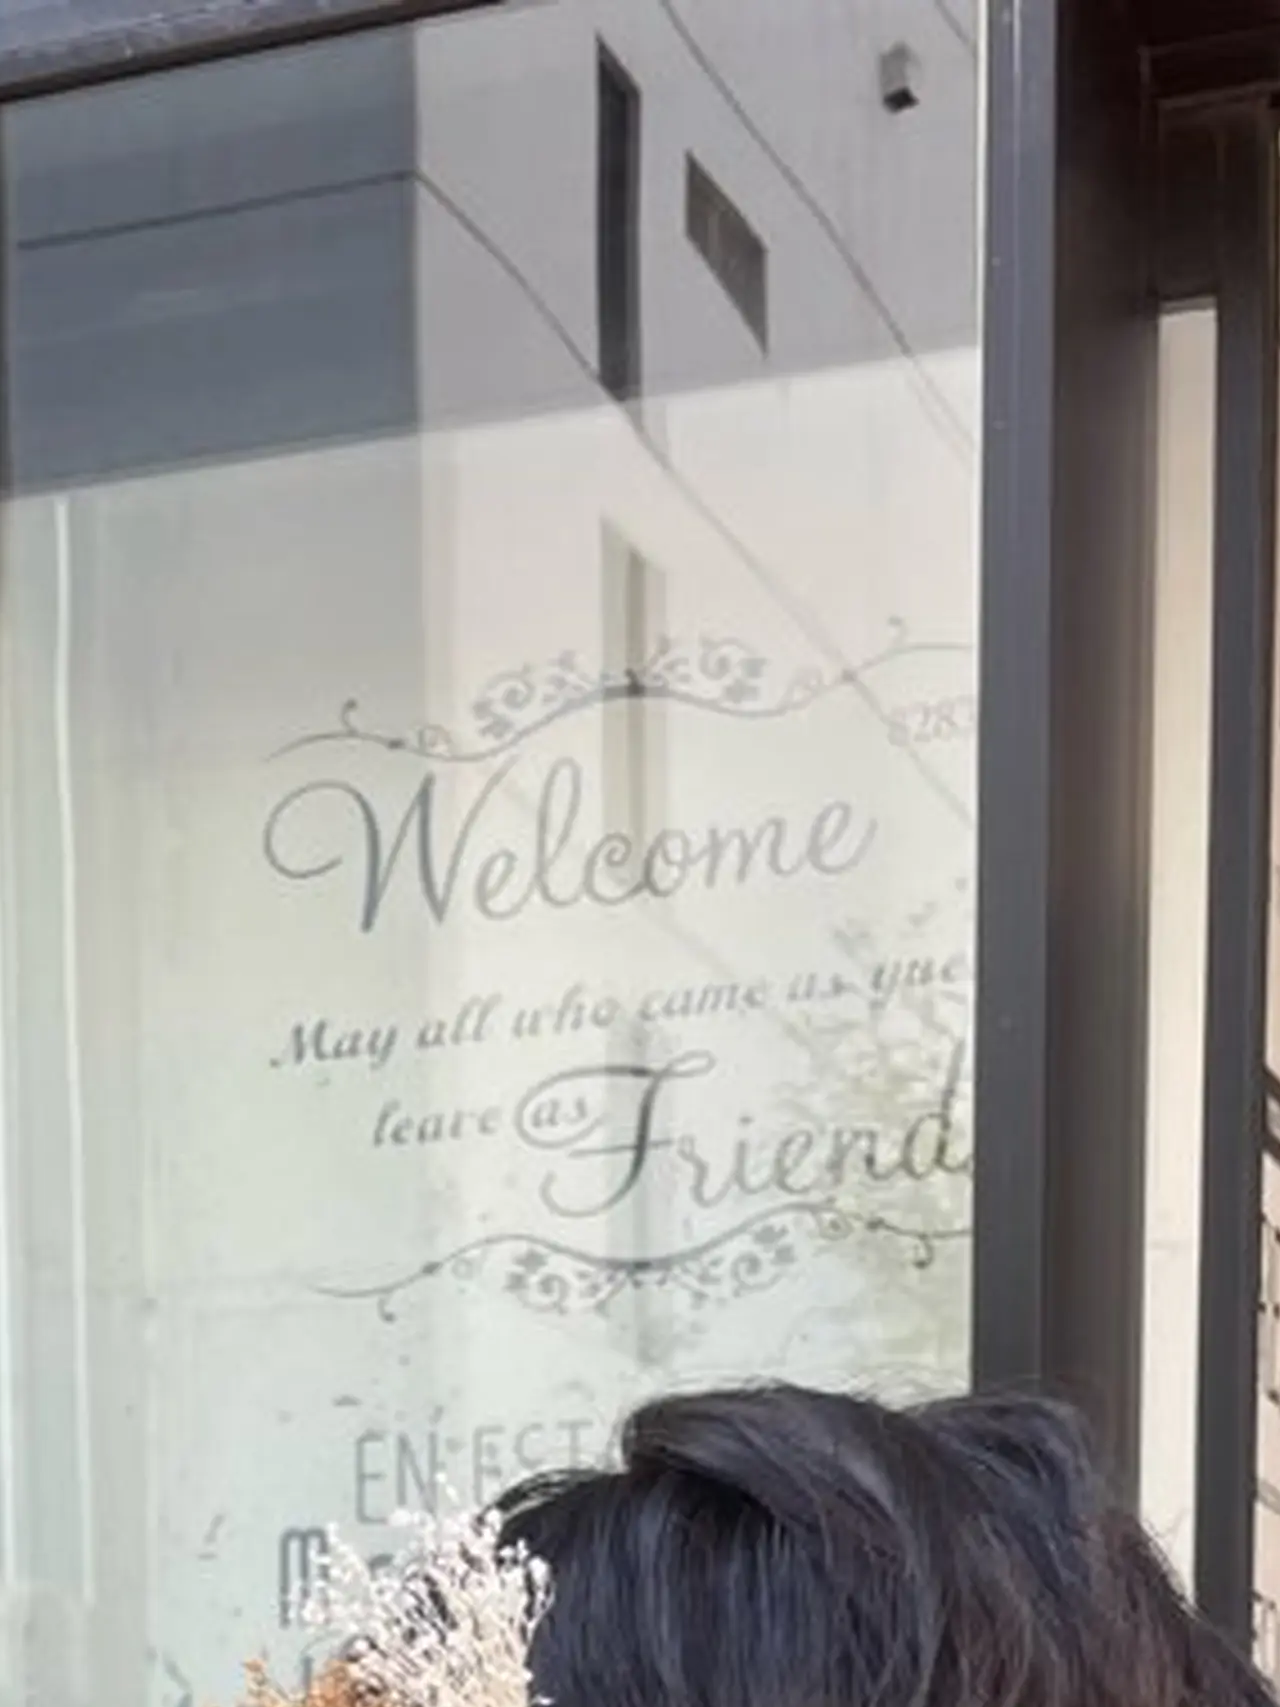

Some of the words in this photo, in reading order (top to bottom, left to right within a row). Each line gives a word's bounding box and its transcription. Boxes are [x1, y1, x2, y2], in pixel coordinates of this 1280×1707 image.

[262, 752, 880, 934] Welcome
[268, 1018, 398, 1071] May
[415, 991, 505, 1050] all
[511, 982, 621, 1040] who
[529, 1096, 588, 1130] as
